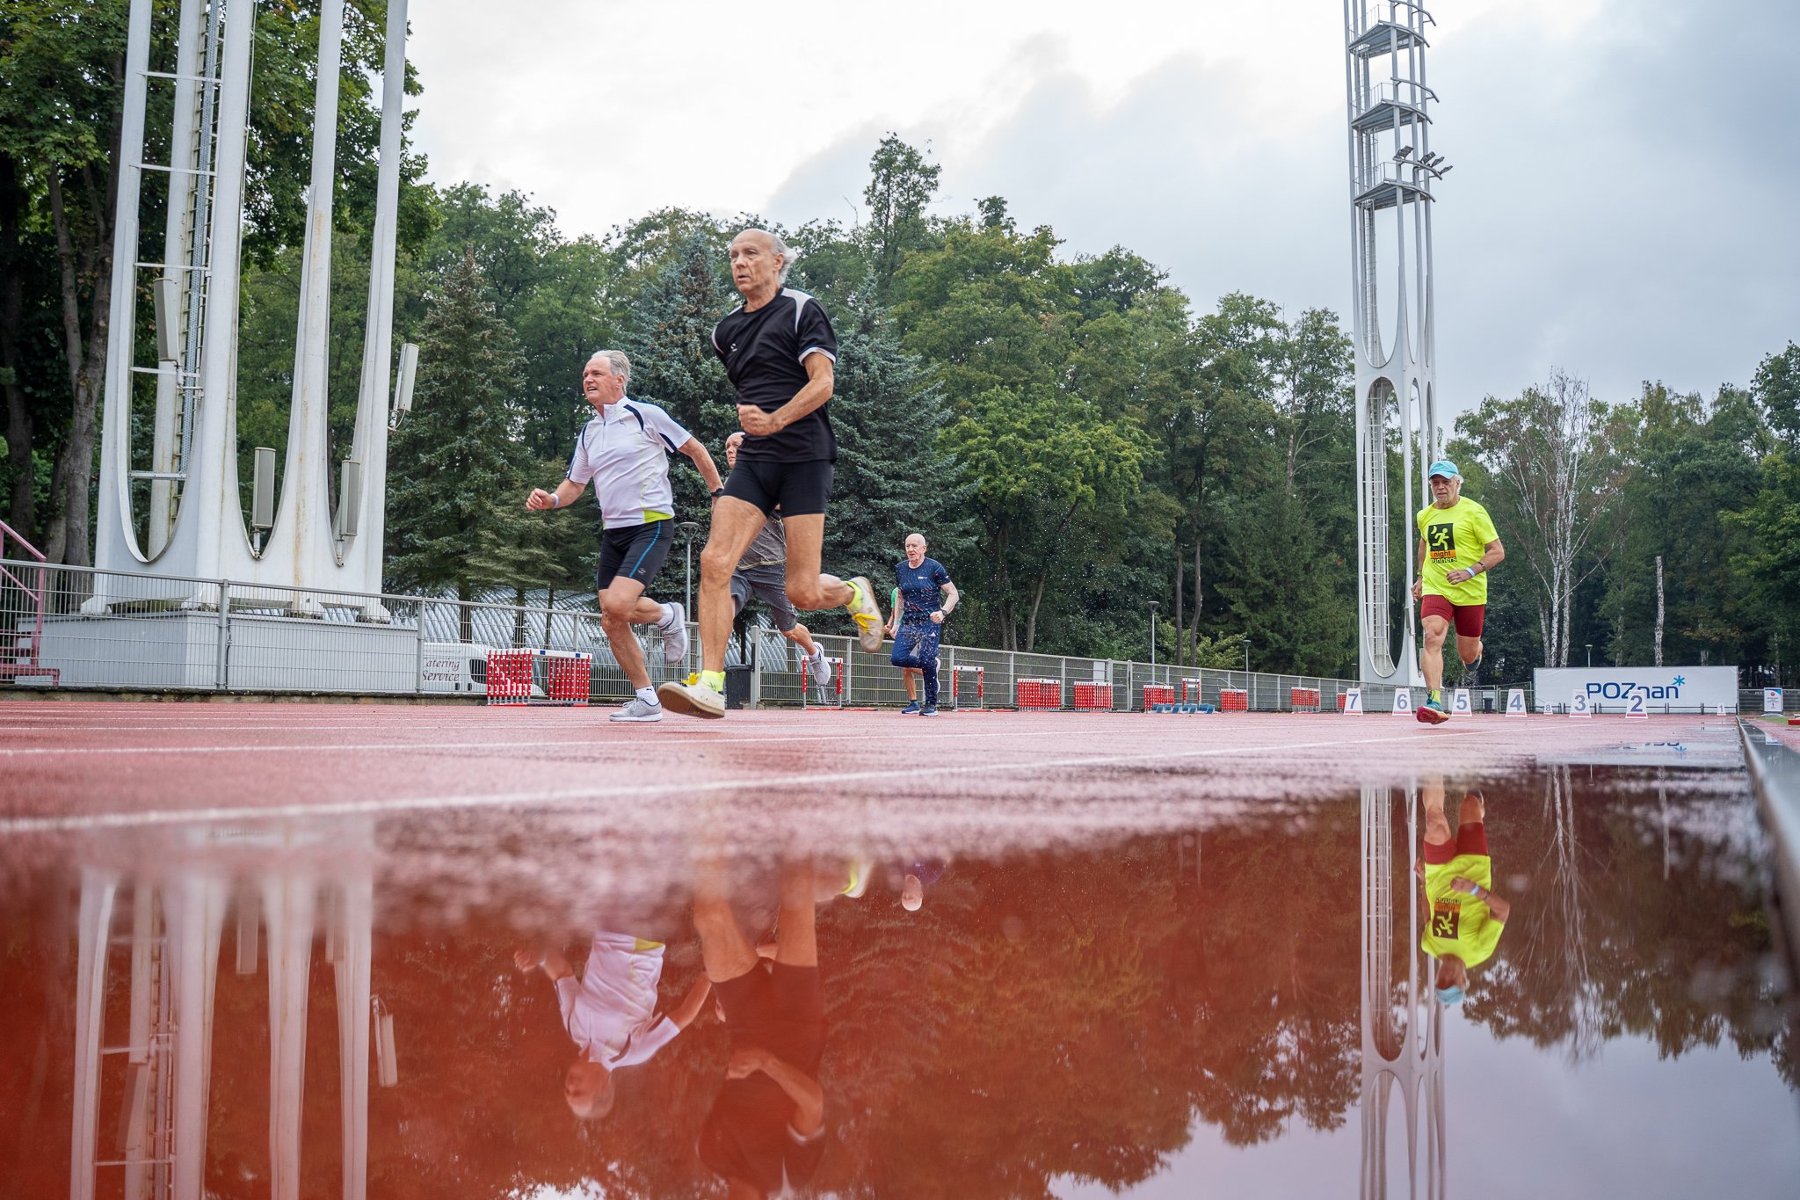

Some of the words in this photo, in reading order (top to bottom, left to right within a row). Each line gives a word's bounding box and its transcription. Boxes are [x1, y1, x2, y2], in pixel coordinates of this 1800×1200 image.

[424, 657, 460, 671] atering
[422, 670, 460, 681] Service
[1348, 693, 1359, 710] 7
[1396, 693, 1408, 710] 6
[1456, 694, 1468, 711] 5
[1509, 693, 1523, 711] 4
[1574, 694, 1587, 711] 3
[1630, 695, 1643, 712] 2
